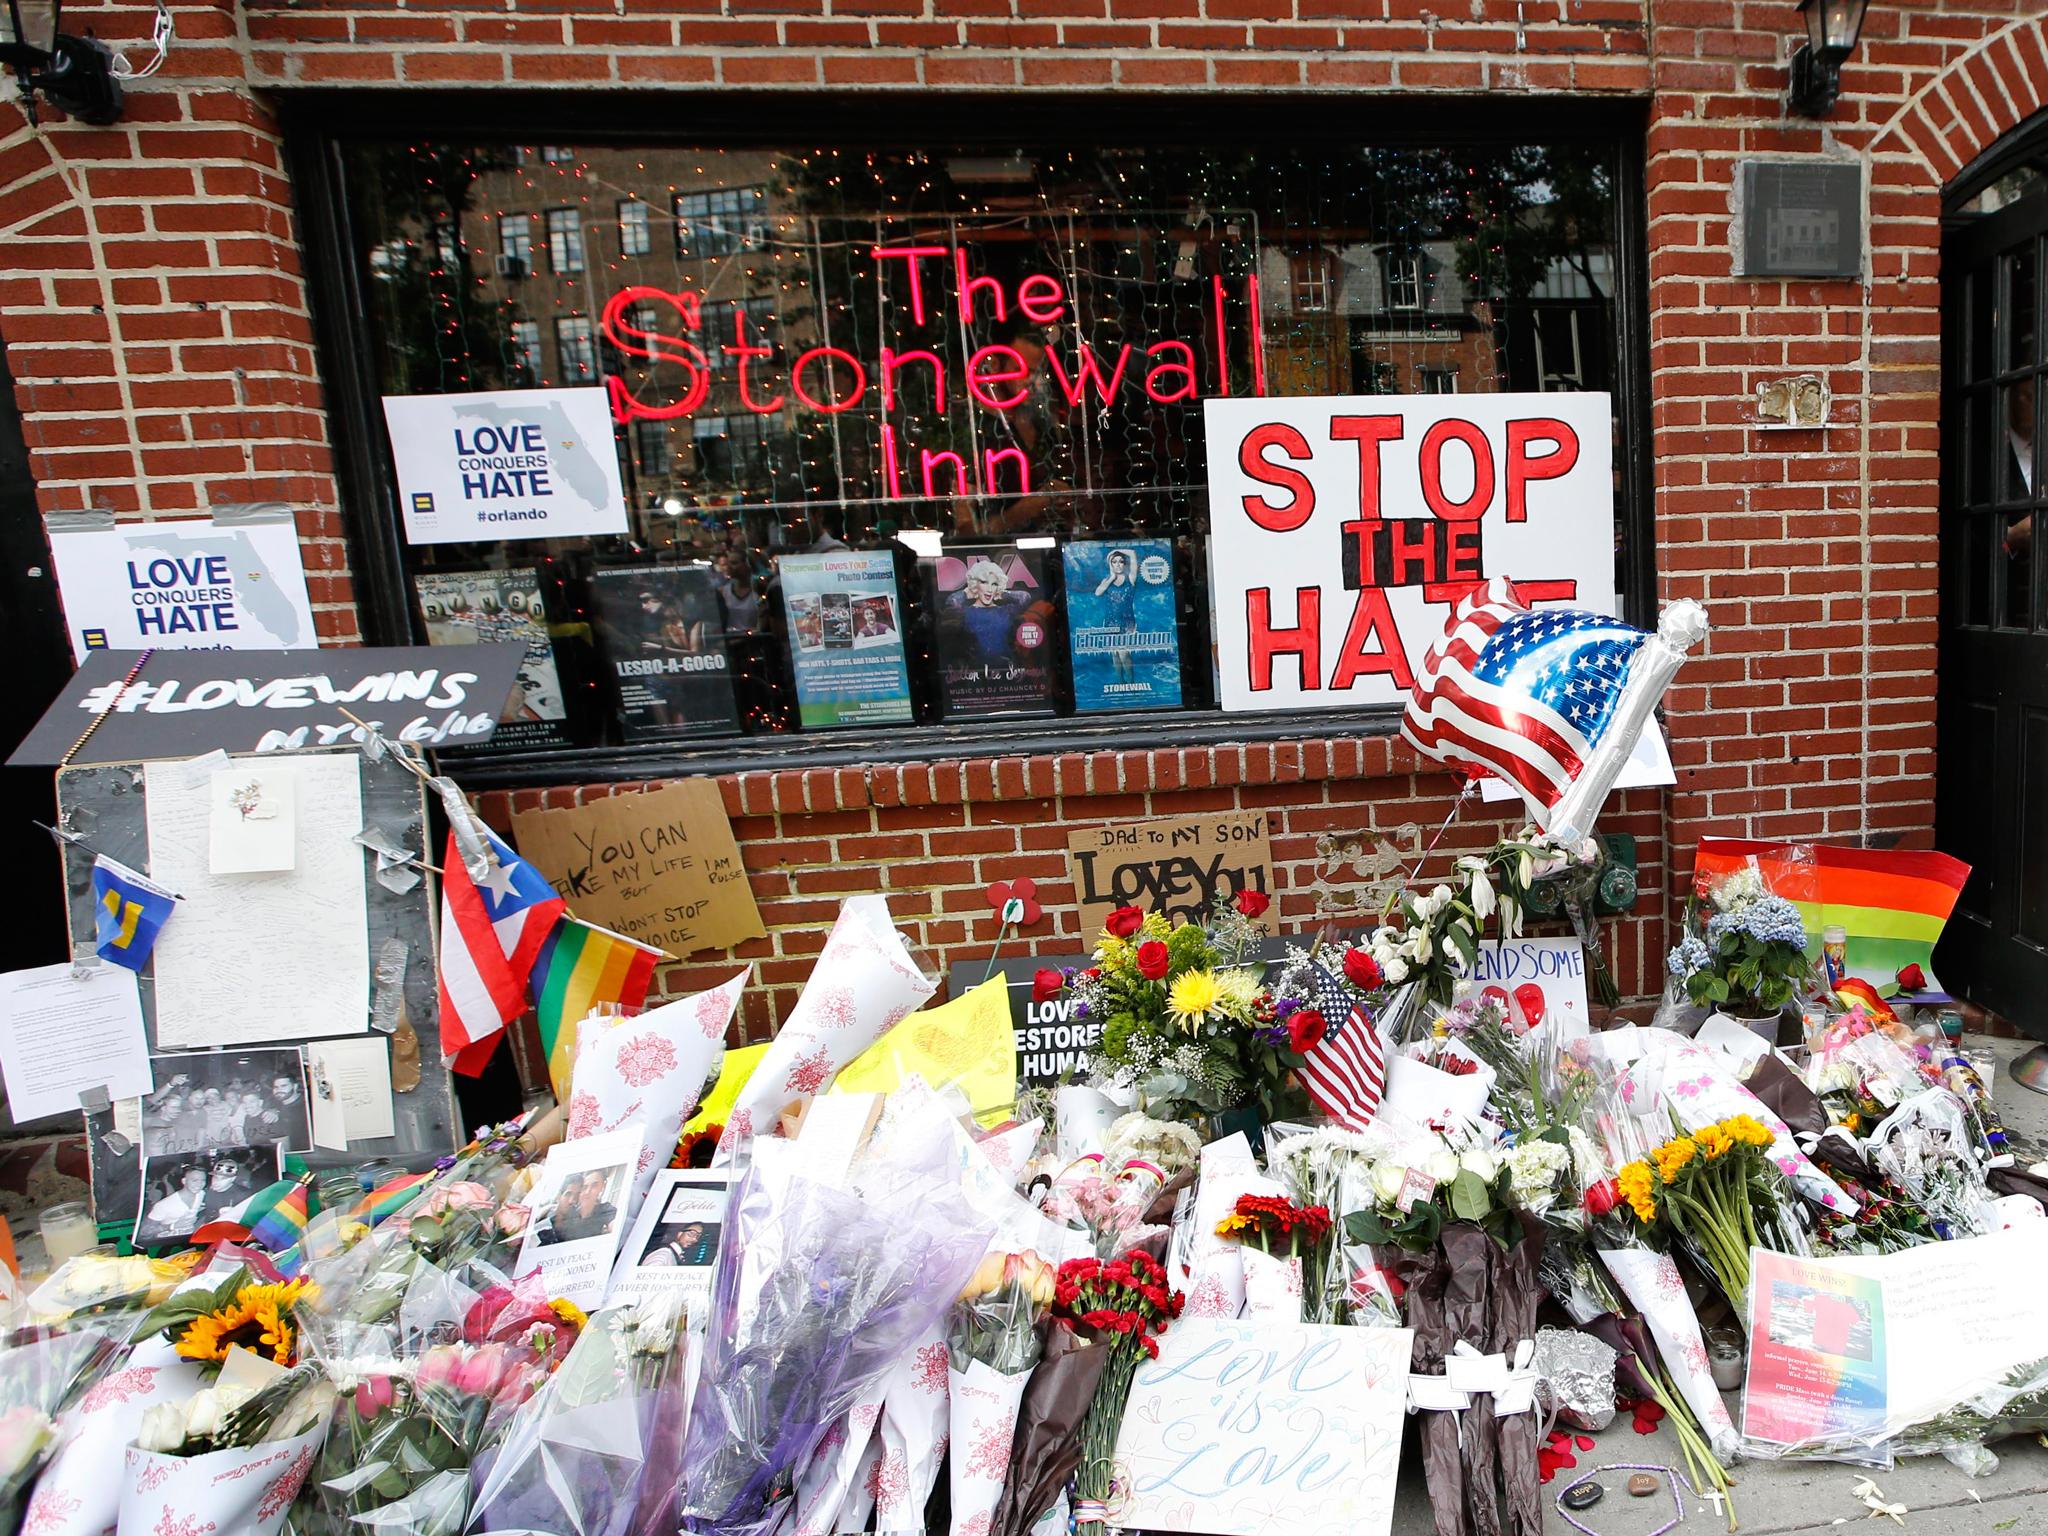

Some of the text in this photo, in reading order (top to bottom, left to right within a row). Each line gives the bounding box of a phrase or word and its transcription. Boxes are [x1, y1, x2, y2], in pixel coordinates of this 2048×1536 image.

[872, 246, 1066, 325] The
[602, 275, 1266, 424] Stonewall
[454, 425, 546, 455] LOVE
[457, 455, 548, 471] CONQUERS
[881, 423, 1031, 500] Inn
[1238, 414, 1580, 532] STOP
[462, 470, 553, 499] HATE
[477, 508, 548, 522] #orlando
[825, 561, 848, 571] Loves
[849, 560, 868, 570] Your
[1342, 519, 1482, 588] THE
[127, 556, 232, 589] LOVE
[837, 571, 894, 582] Photo Contest
[131, 587, 233, 606] CONQUERS
[136, 603, 239, 635] HATE
[1245, 579, 1577, 692] HA
[616, 654, 727, 677] LESBO-A-GOGO
[78, 669, 478, 715] #LOVEWINS
[1103, 682, 1153, 694] STONEWALL
[640, 820, 689, 855] CAN
[1171, 825, 1201, 848] MY
[1215, 817, 1263, 843] SON
[549, 855, 694, 900] TAKE MY LIFE
[704, 857, 731, 872] I AM
[707, 868, 743, 885] PULSE
[621, 883, 653, 901] BUT
[664, 900, 711, 923] STOP
[1521, 943, 1584, 980] SOME
[567, 1251, 594, 1264] PEACE
[613, 1283, 650, 1293] JAVIER
[635, 1272, 705, 1281] REST IN PEACE
[1792, 1267, 1817, 1280] LOVE
[1138, 1330, 1354, 1393] Love
[1775, 1383, 1795, 1392] PRIDE
[1218, 1387, 1262, 1434] is
[1134, 1407, 1352, 1499] Love
[1572, 1484, 1594, 1497] Hope
